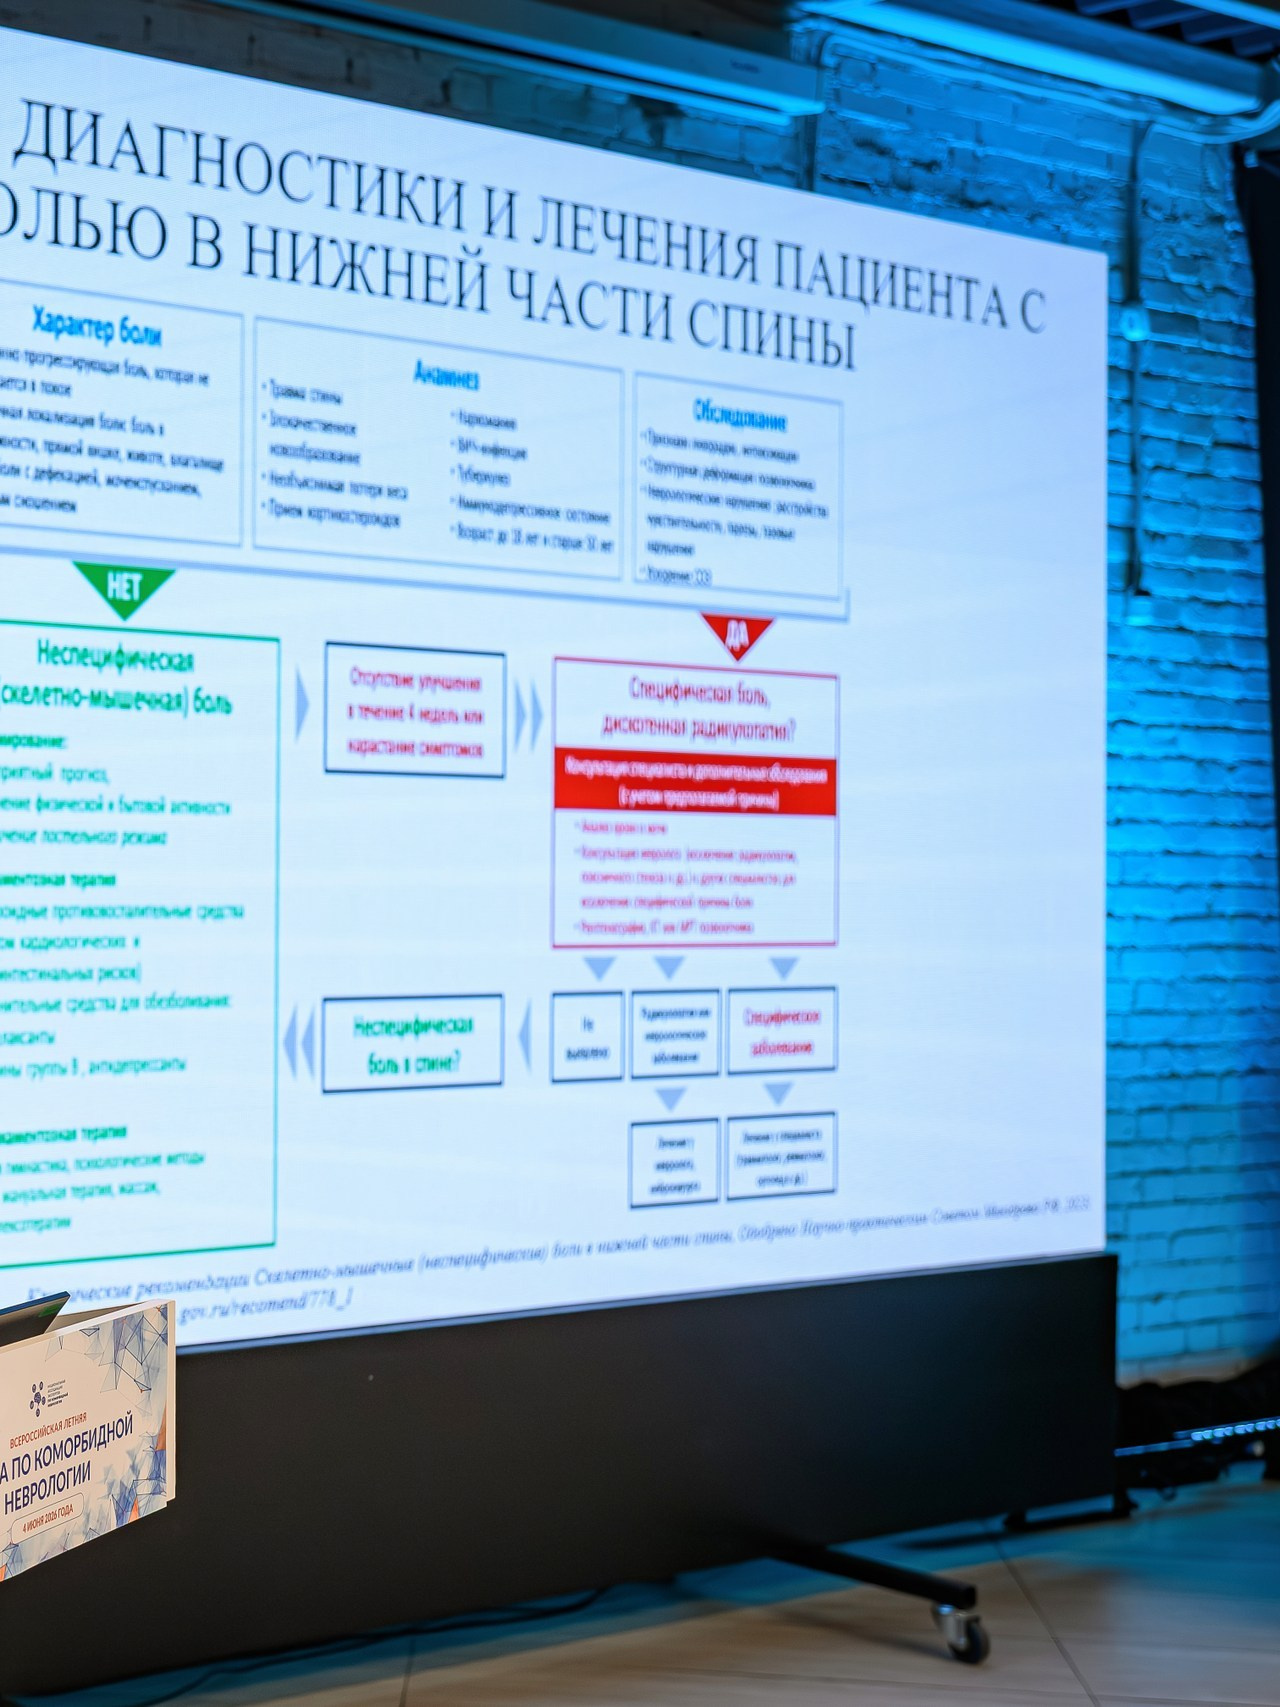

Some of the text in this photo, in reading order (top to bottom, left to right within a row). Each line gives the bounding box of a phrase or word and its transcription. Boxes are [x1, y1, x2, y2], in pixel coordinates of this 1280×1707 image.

[12, 98, 466, 231] ДИАГНОСТИКИ
[481, 185, 518, 242] И
[532, 196, 760, 285] ЛЕЧЕНИЯ
[772, 240, 1010, 331] ПАЦИЕНТА
[1018, 288, 1047, 335] С
[186, 213, 223, 270] В
[240, 222, 490, 313] НИЖНЕЙ
[507, 266, 675, 341] ЧАСТИ
[687, 298, 857, 371] СПИНЫ
[32, 305, 162, 348] Характер боли
[413, 358, 480, 392] Анамнез
[106, 572, 143, 601] НЕТ
[726, 620, 749, 649] ДА
[38, 638, 195, 676] Неспецифическая
[193, 687, 233, 715] боль
[9, 1412, 87, 1450] ВСЕРОССИЙСКАЯ ЛЕТНЯЯ
[11, 1453, 31, 1481] ПО
[34, 1409, 133, 1471] КОМОРБИДНОЙ
[4, 1460, 91, 1515] НЕВРОЛОГИИ
[22, 1522, 28, 1534] 4
[27, 1516, 44, 1532] ИЮНЯ
[58, 1503, 74, 1522] ГОДА
